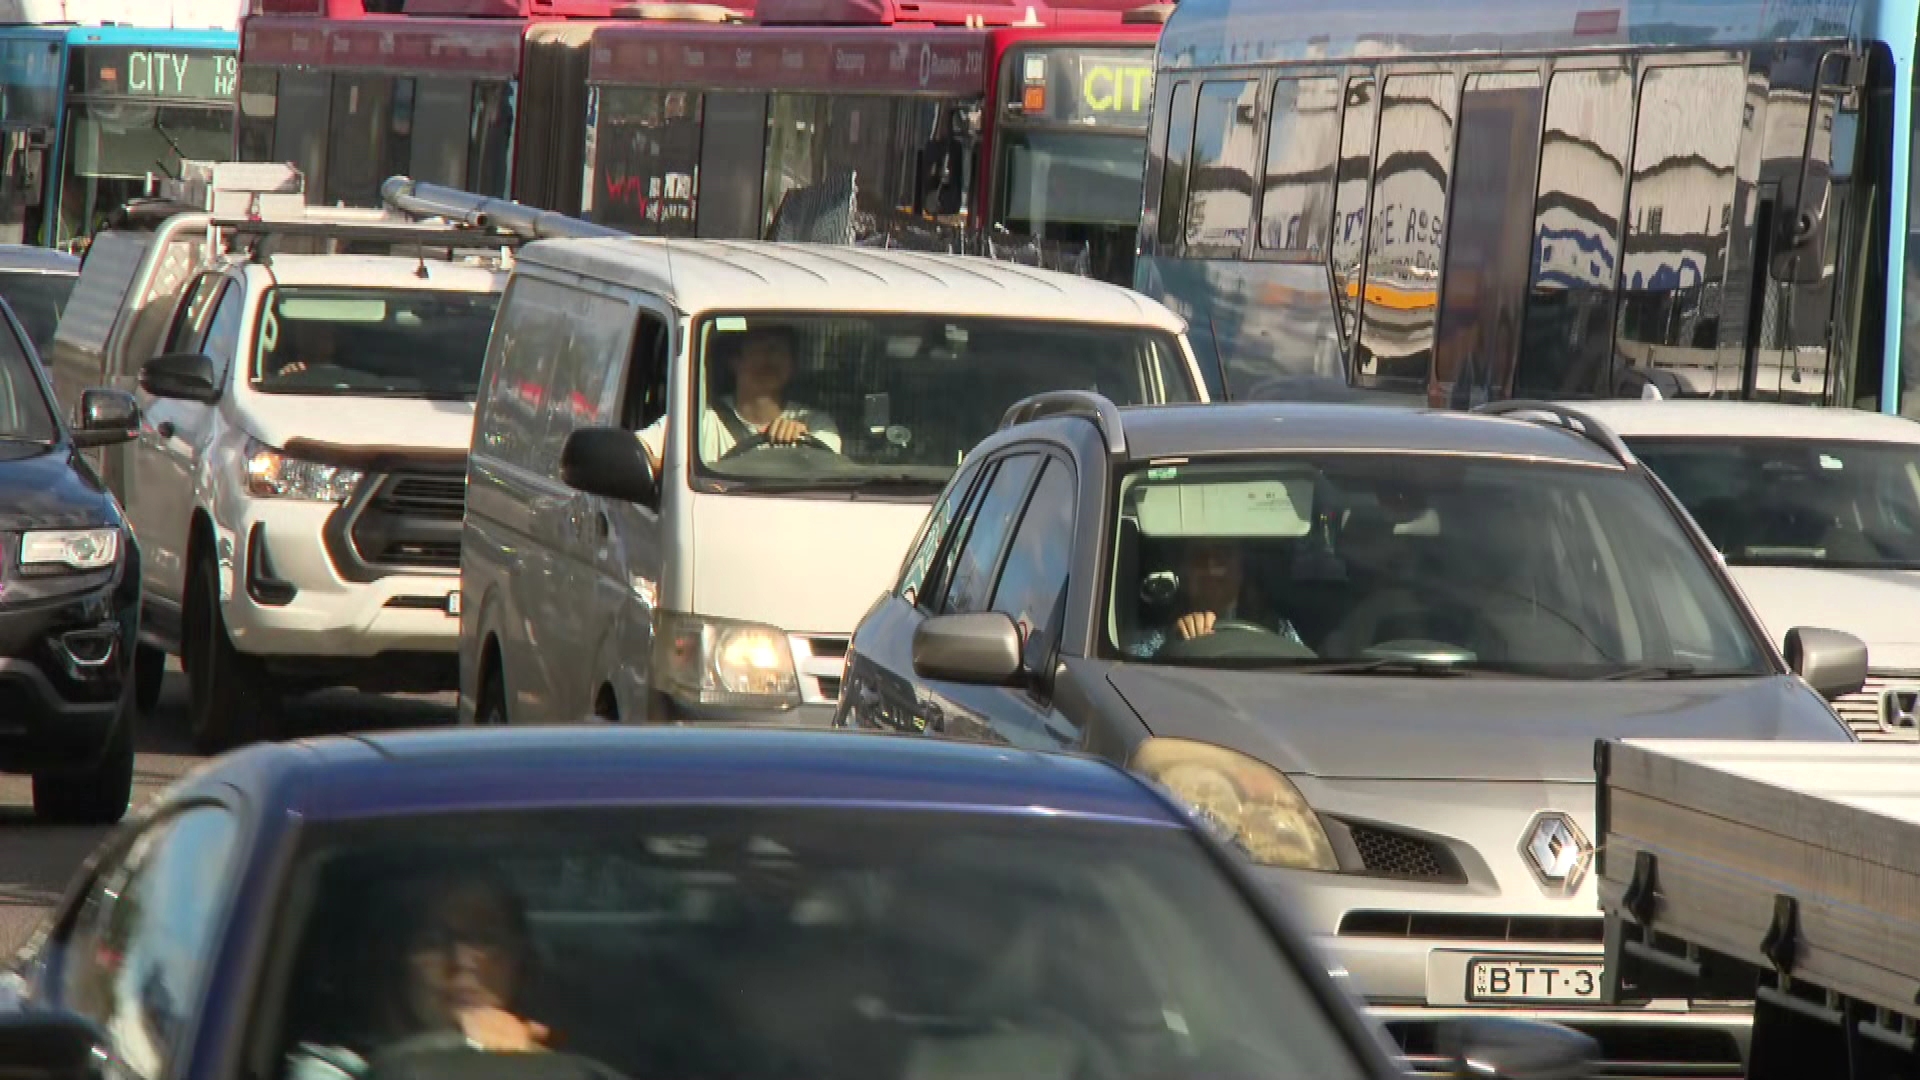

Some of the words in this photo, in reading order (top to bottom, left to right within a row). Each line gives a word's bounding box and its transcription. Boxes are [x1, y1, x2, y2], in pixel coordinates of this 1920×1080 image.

[128, 51, 189, 92] CITY
[1083, 66, 1152, 112] CIT
[1490, 966, 1604, 996] BTT·3
